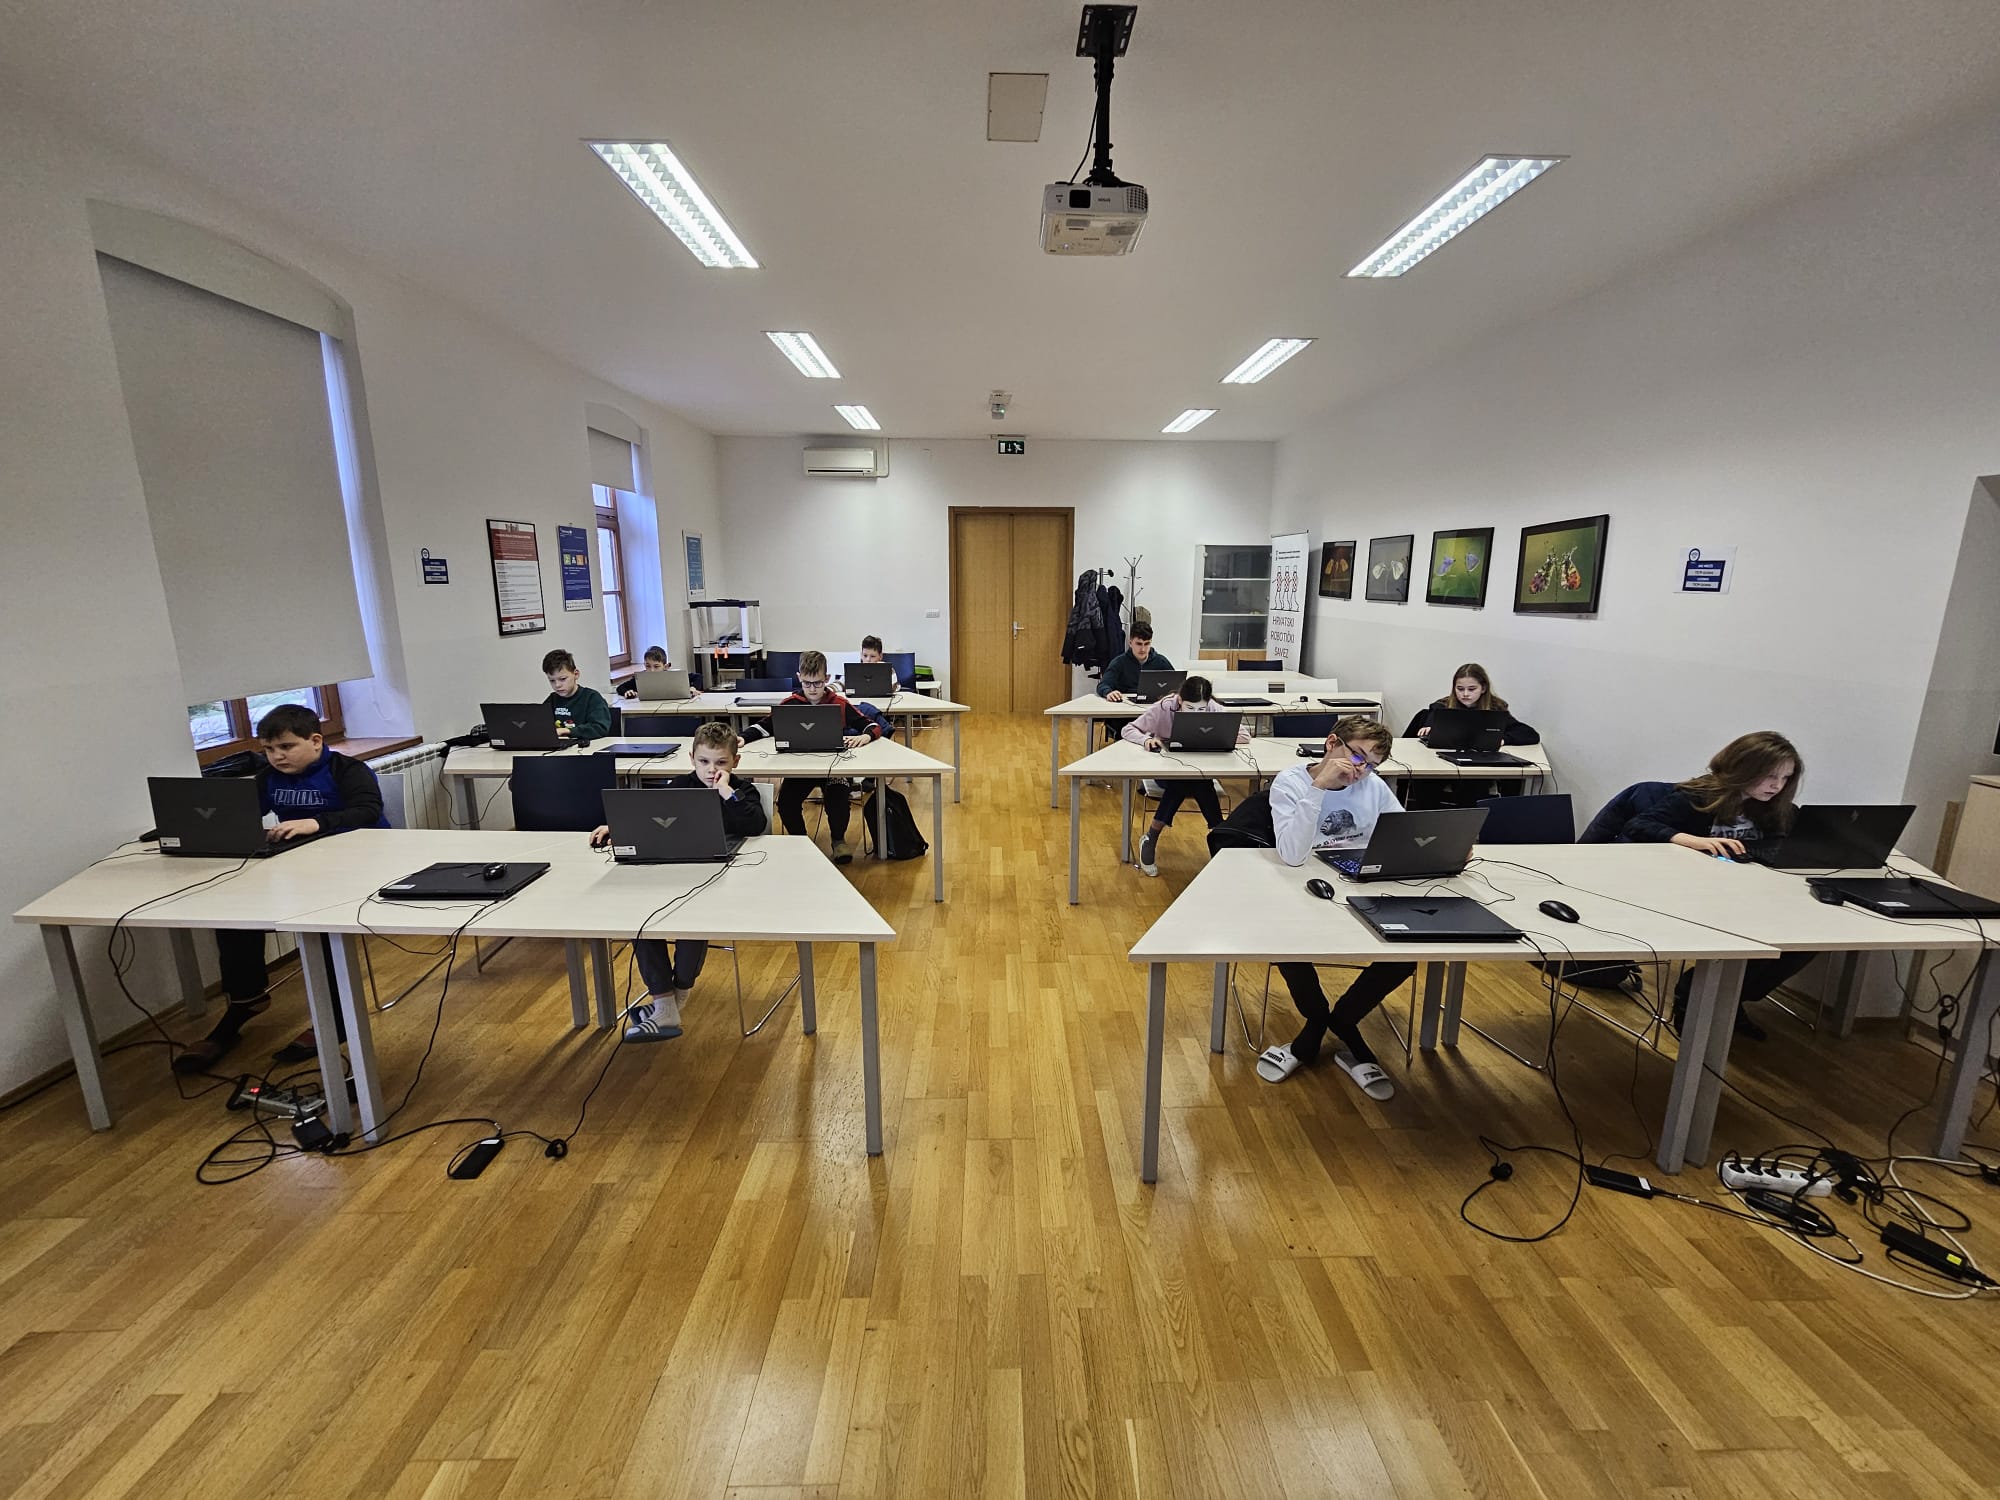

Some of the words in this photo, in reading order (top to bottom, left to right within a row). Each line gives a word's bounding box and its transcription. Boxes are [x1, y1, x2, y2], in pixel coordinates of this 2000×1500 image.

[1272, 616, 1295, 627] HRVATSKI
[1270, 630, 1295, 644] ROBOTIČKI
[1274, 646, 1289, 659] SAVEZ
[274, 788, 324, 806] PUMA
